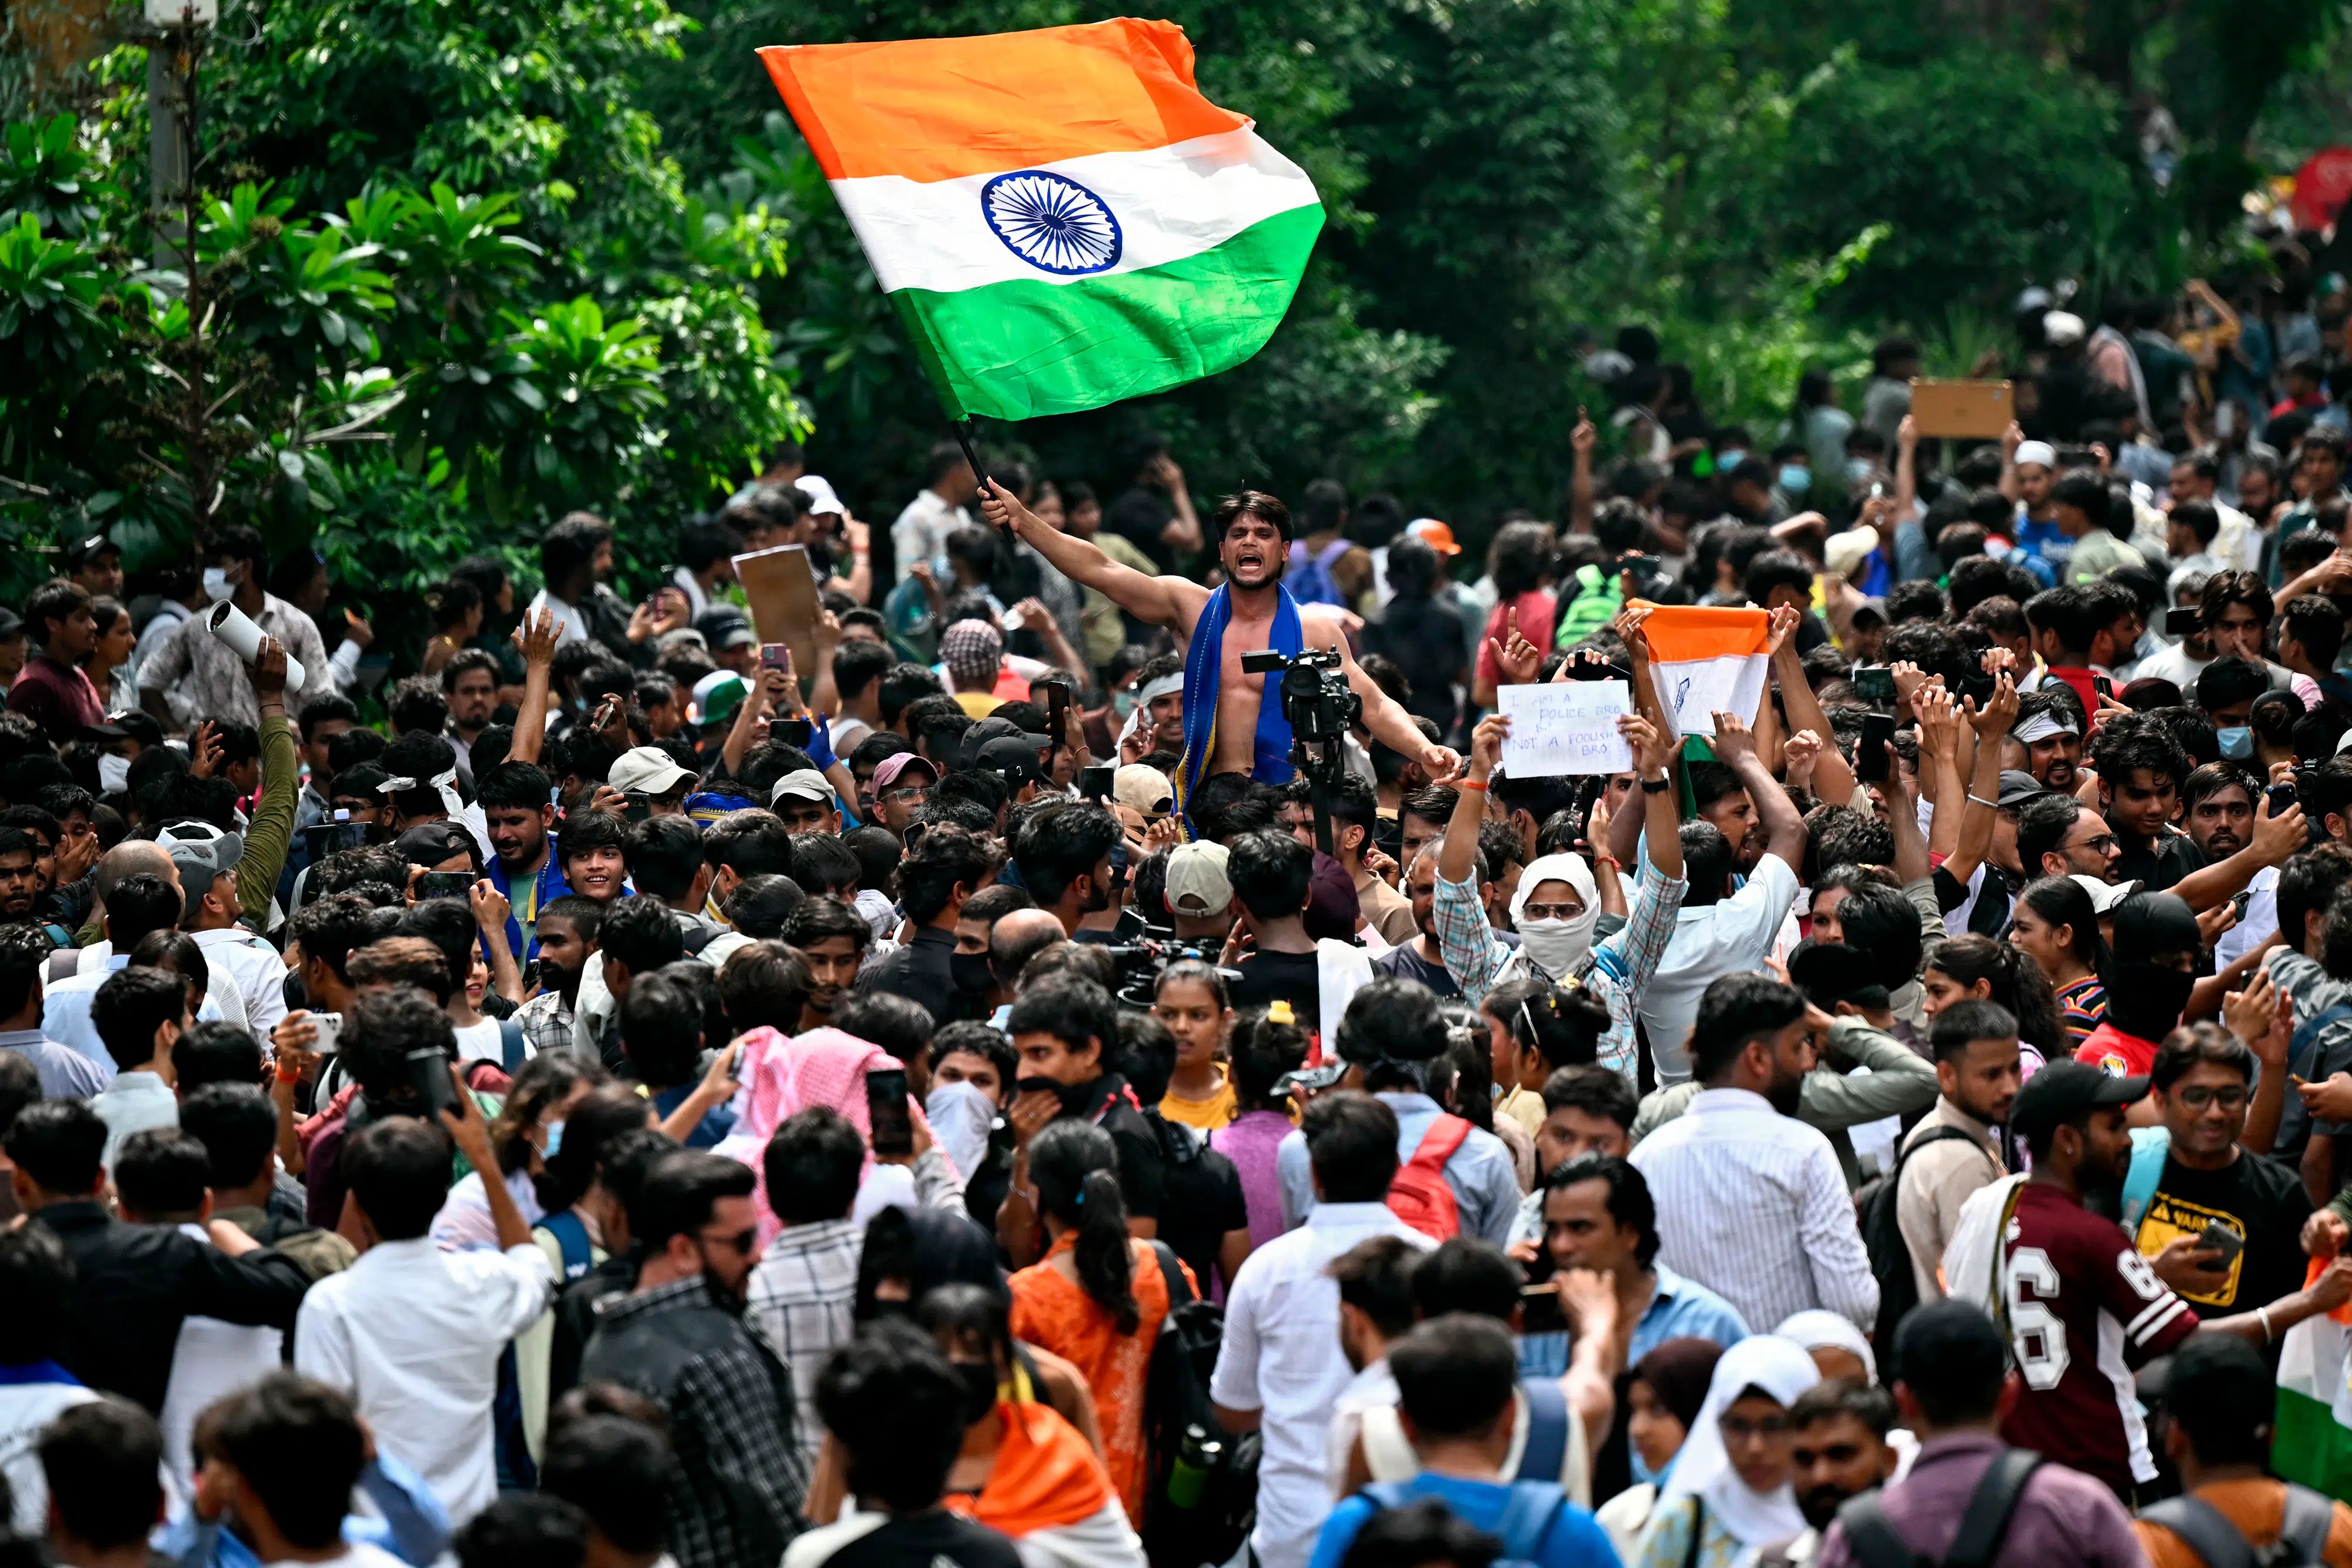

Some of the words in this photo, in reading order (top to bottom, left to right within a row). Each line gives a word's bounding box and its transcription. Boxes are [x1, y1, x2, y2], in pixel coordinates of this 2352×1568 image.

[1506, 693, 1520, 708] I
[1532, 694, 1553, 706] AM
[1563, 693, 1571, 704] A
[1539, 707, 1586, 722] POLICE
[1595, 705, 1622, 716] BRO
[1512, 737, 1537, 752] NOT
[1548, 736, 1559, 747] A
[1581, 744, 1608, 757] BRO
[2006, 1246, 2071, 1390] 6
